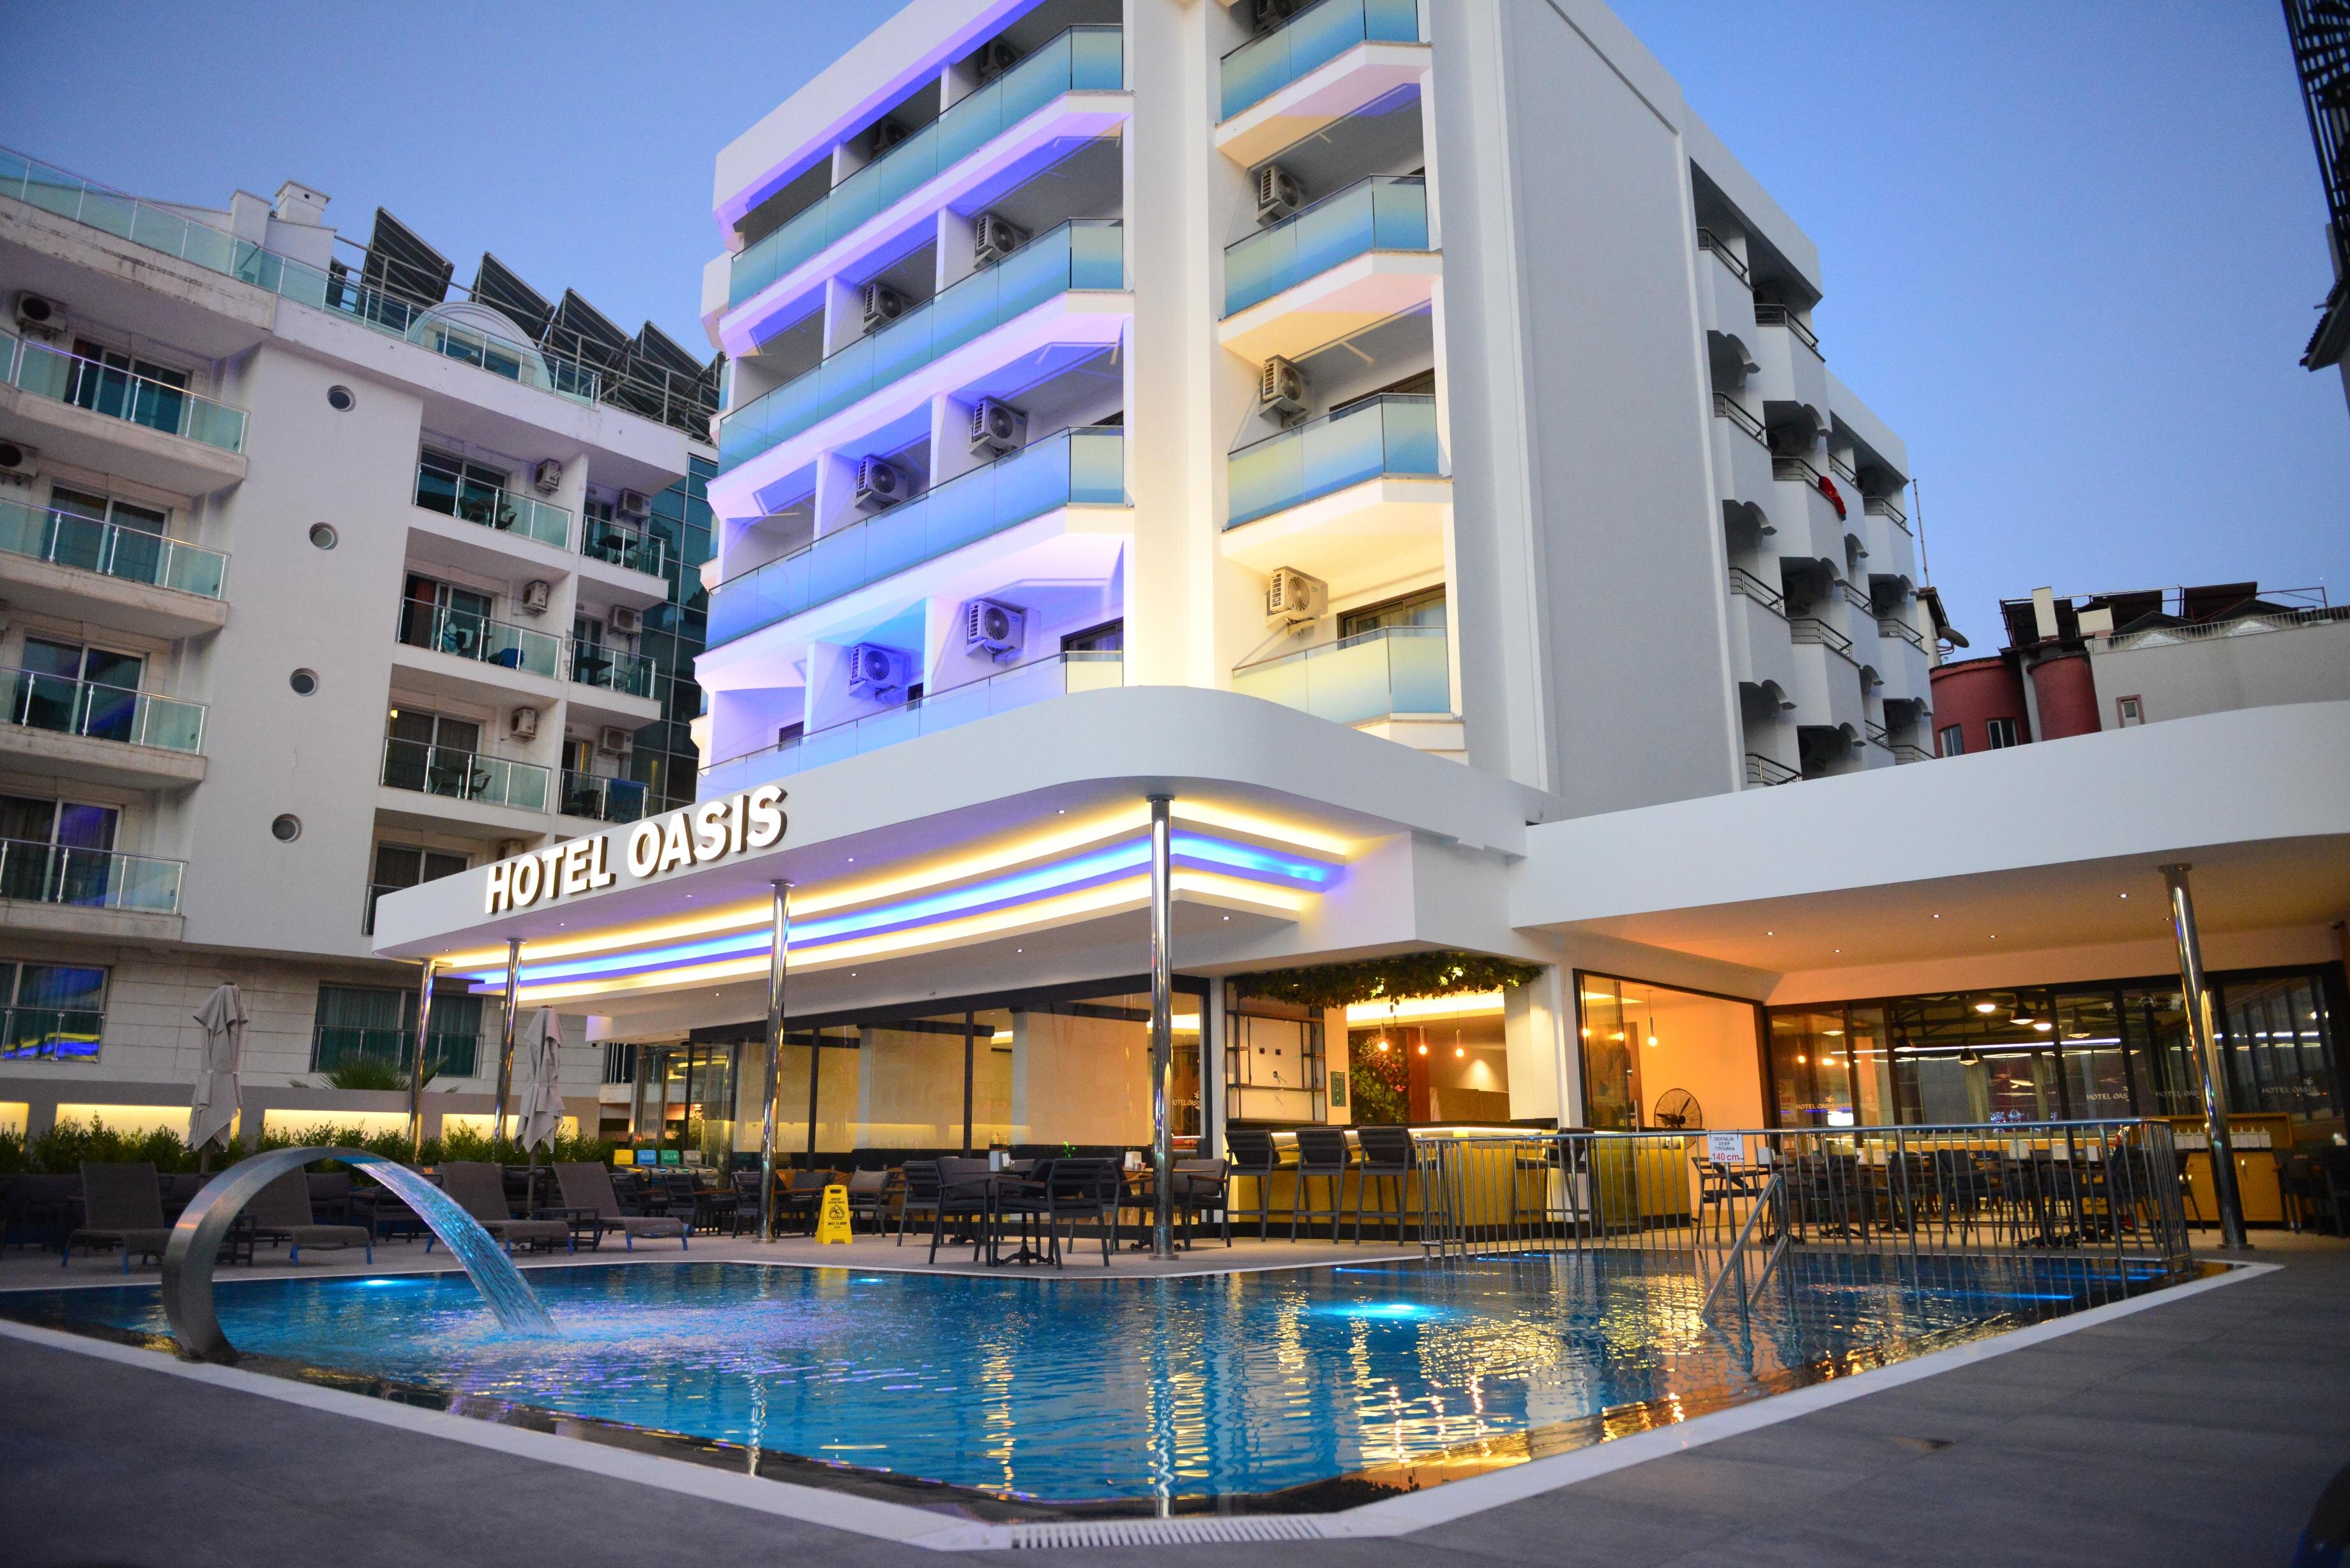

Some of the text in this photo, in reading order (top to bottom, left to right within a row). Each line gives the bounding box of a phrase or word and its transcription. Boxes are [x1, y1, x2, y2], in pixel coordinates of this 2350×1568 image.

[485, 785, 788, 914] HOTEL OASIS
[1712, 1152, 1725, 1161] 140
